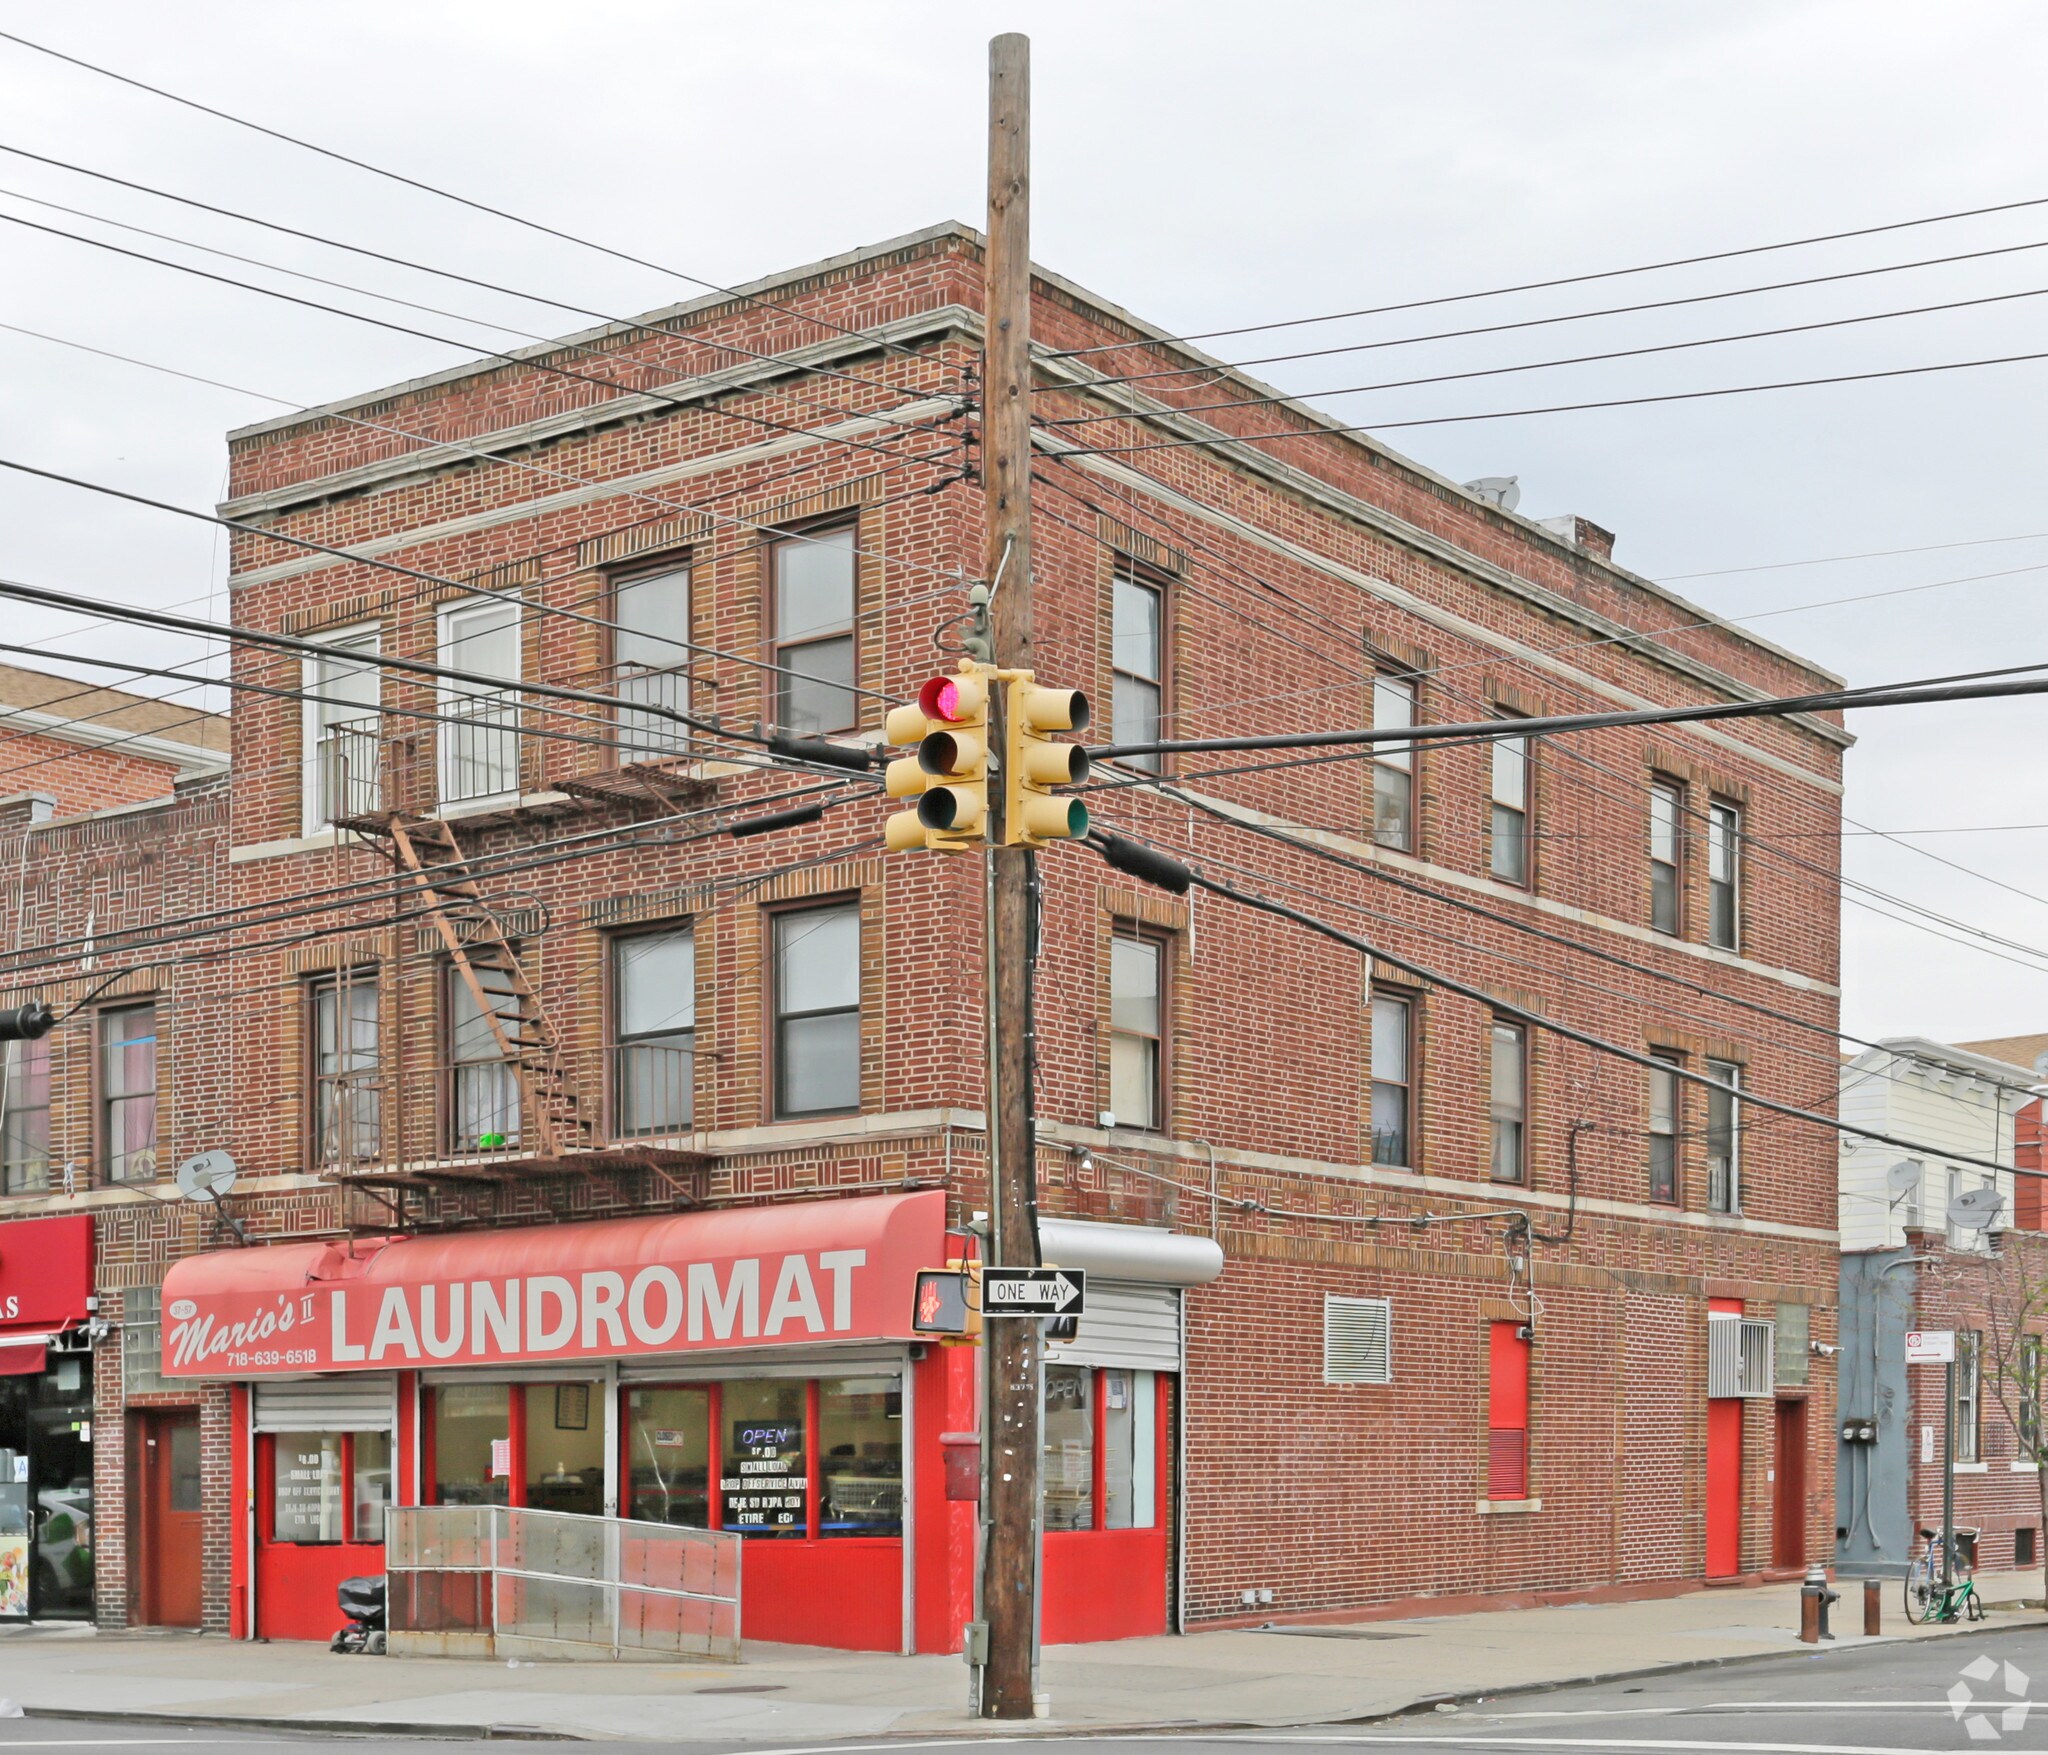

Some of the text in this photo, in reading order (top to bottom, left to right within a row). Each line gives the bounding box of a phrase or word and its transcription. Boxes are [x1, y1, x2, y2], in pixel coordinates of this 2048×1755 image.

[997, 1283, 1069, 1301] ONE WAY
[331, 1249, 867, 1362] LAUNDROMAT
[169, 1294, 295, 1367] Mario's
[227, 1349, 316, 1366] 718-639-6518
[1045, 1377, 1085, 1400] OPEN
[742, 1428, 788, 1445] OPEN
[19, 1460, 27, 1473] A
